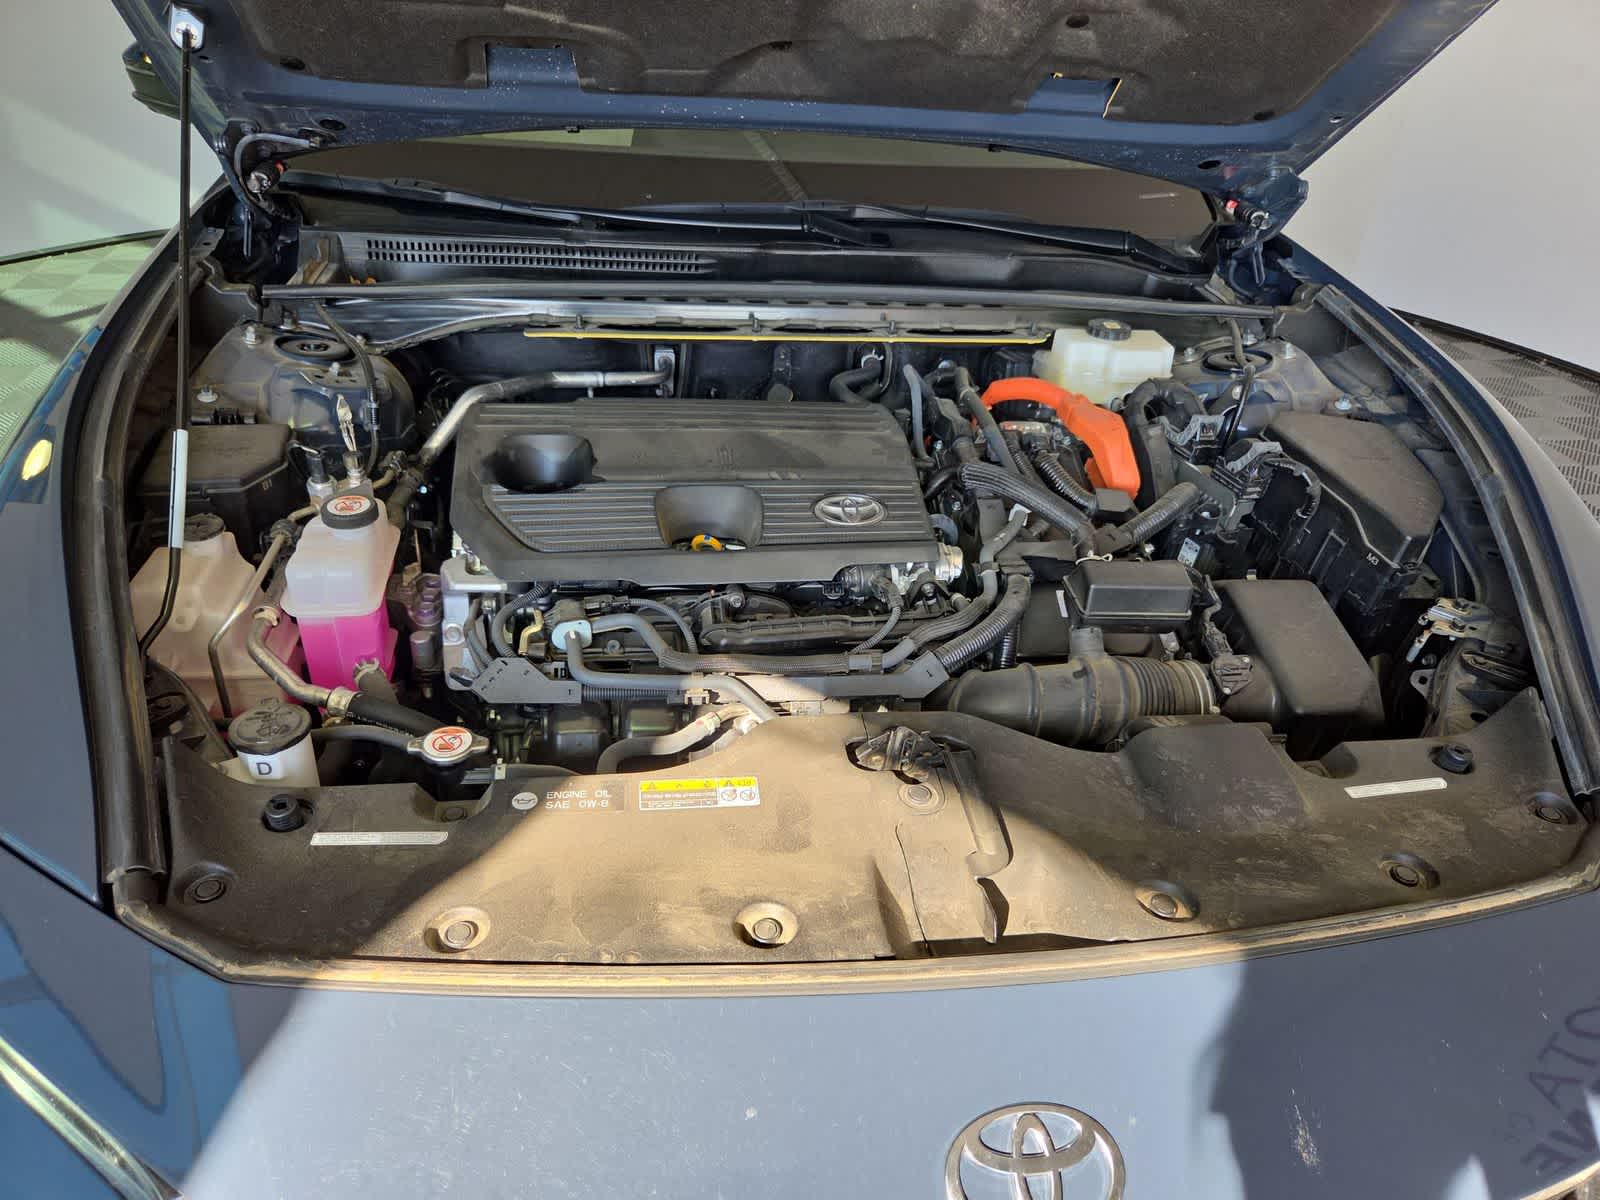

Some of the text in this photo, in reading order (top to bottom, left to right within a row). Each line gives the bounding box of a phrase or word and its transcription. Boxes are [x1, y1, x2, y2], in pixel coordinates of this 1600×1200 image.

[256, 762, 272, 775] D
[546, 790, 613, 799] ENGINE OIL
[544, 800, 569, 809] SAE
